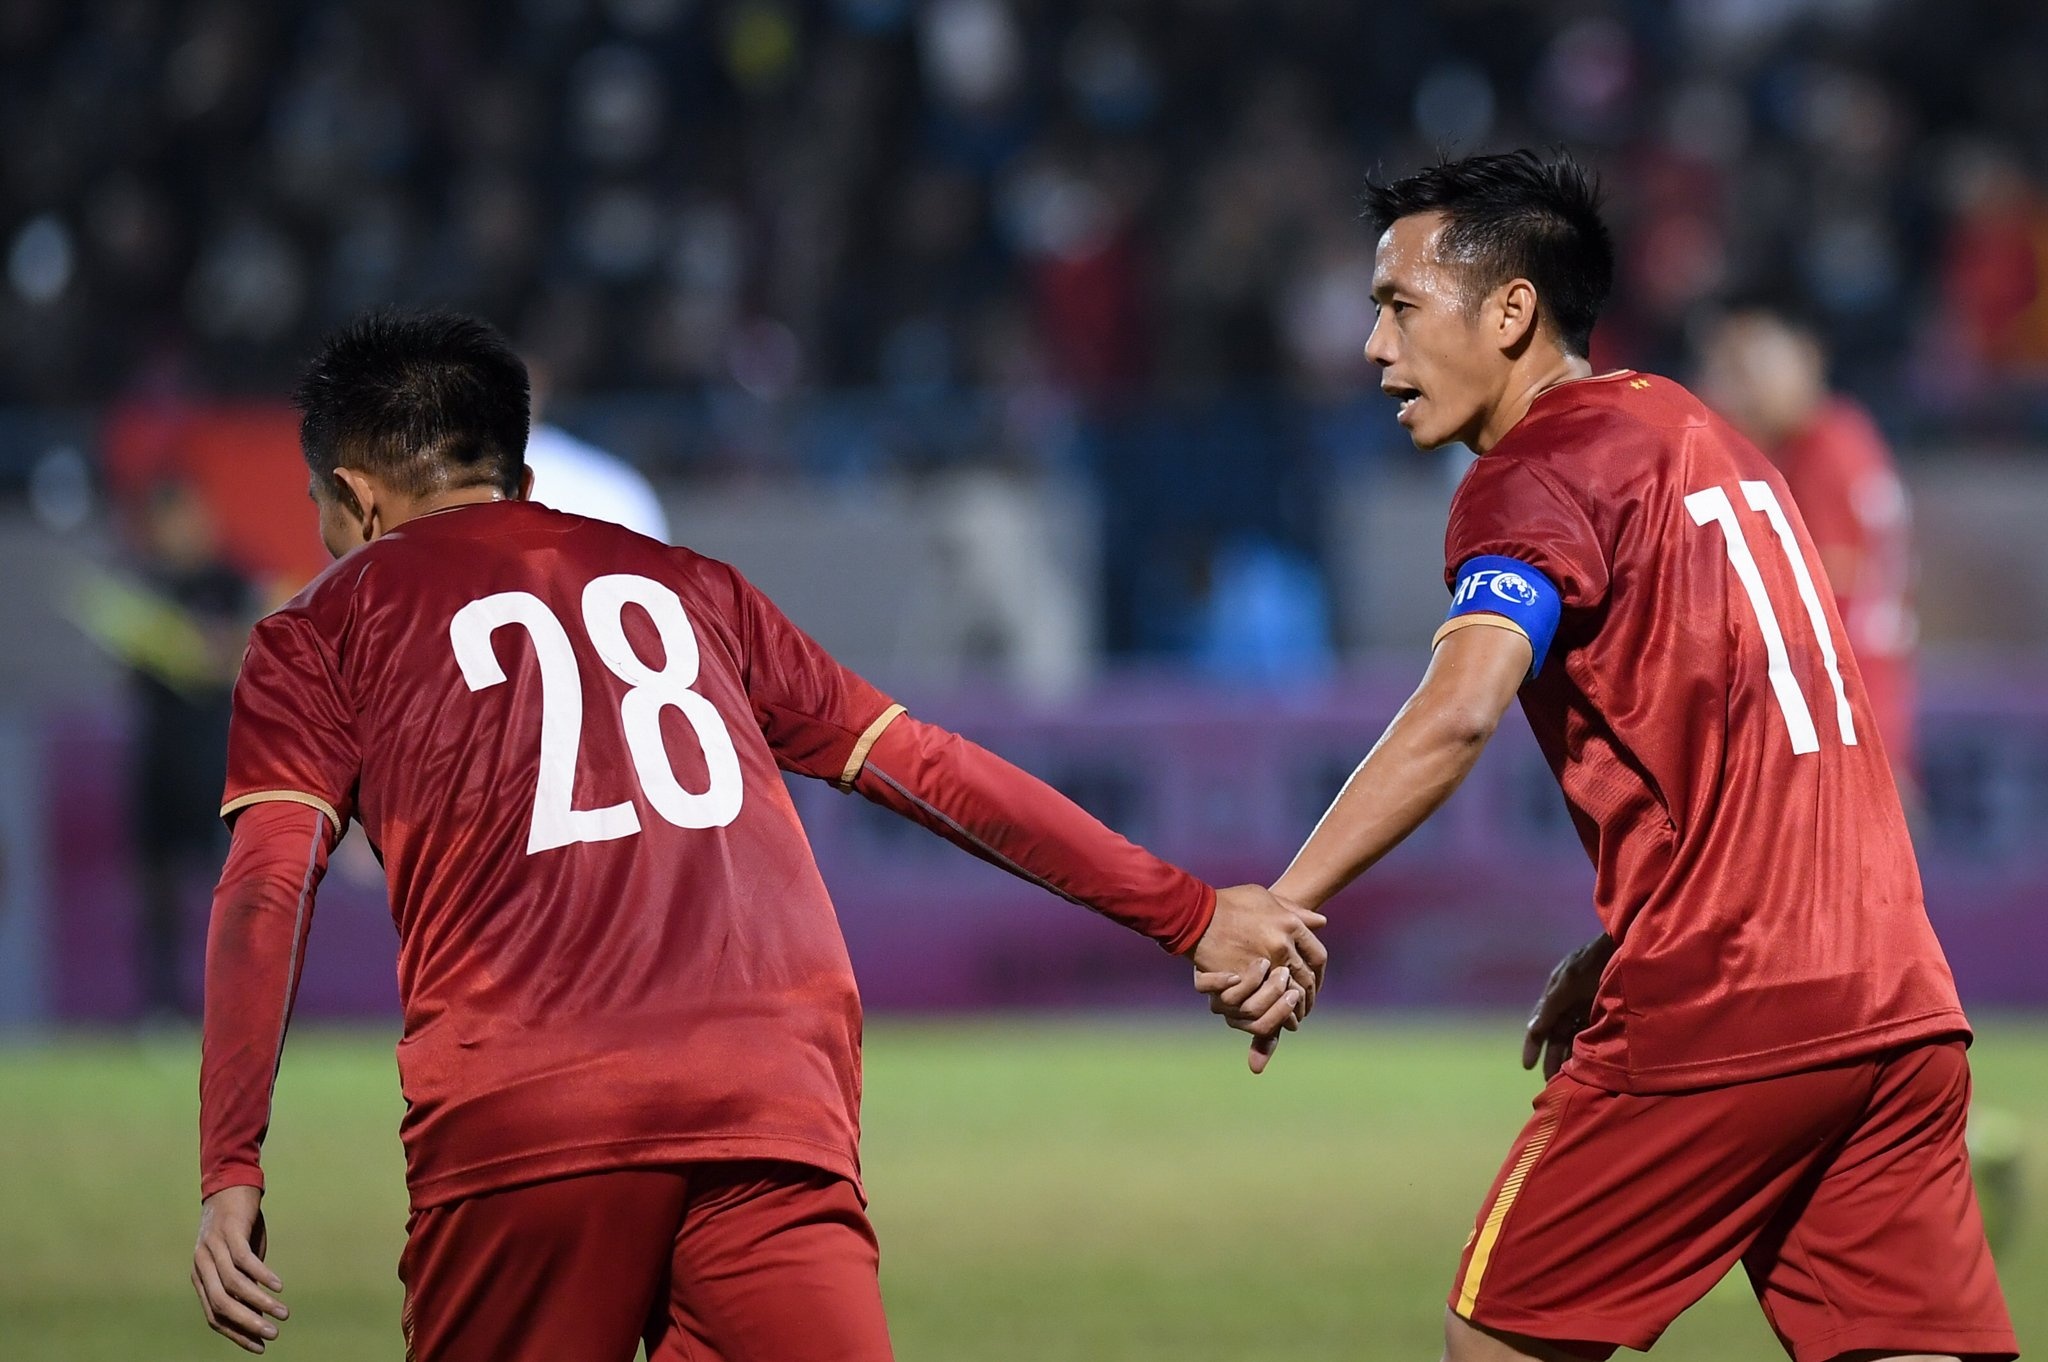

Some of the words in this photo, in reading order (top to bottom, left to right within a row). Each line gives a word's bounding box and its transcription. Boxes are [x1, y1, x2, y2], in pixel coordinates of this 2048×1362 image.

[450, 573, 744, 855] 28
[1450, 570, 1535, 608] AFC
[1684, 480, 1857, 755] 11
